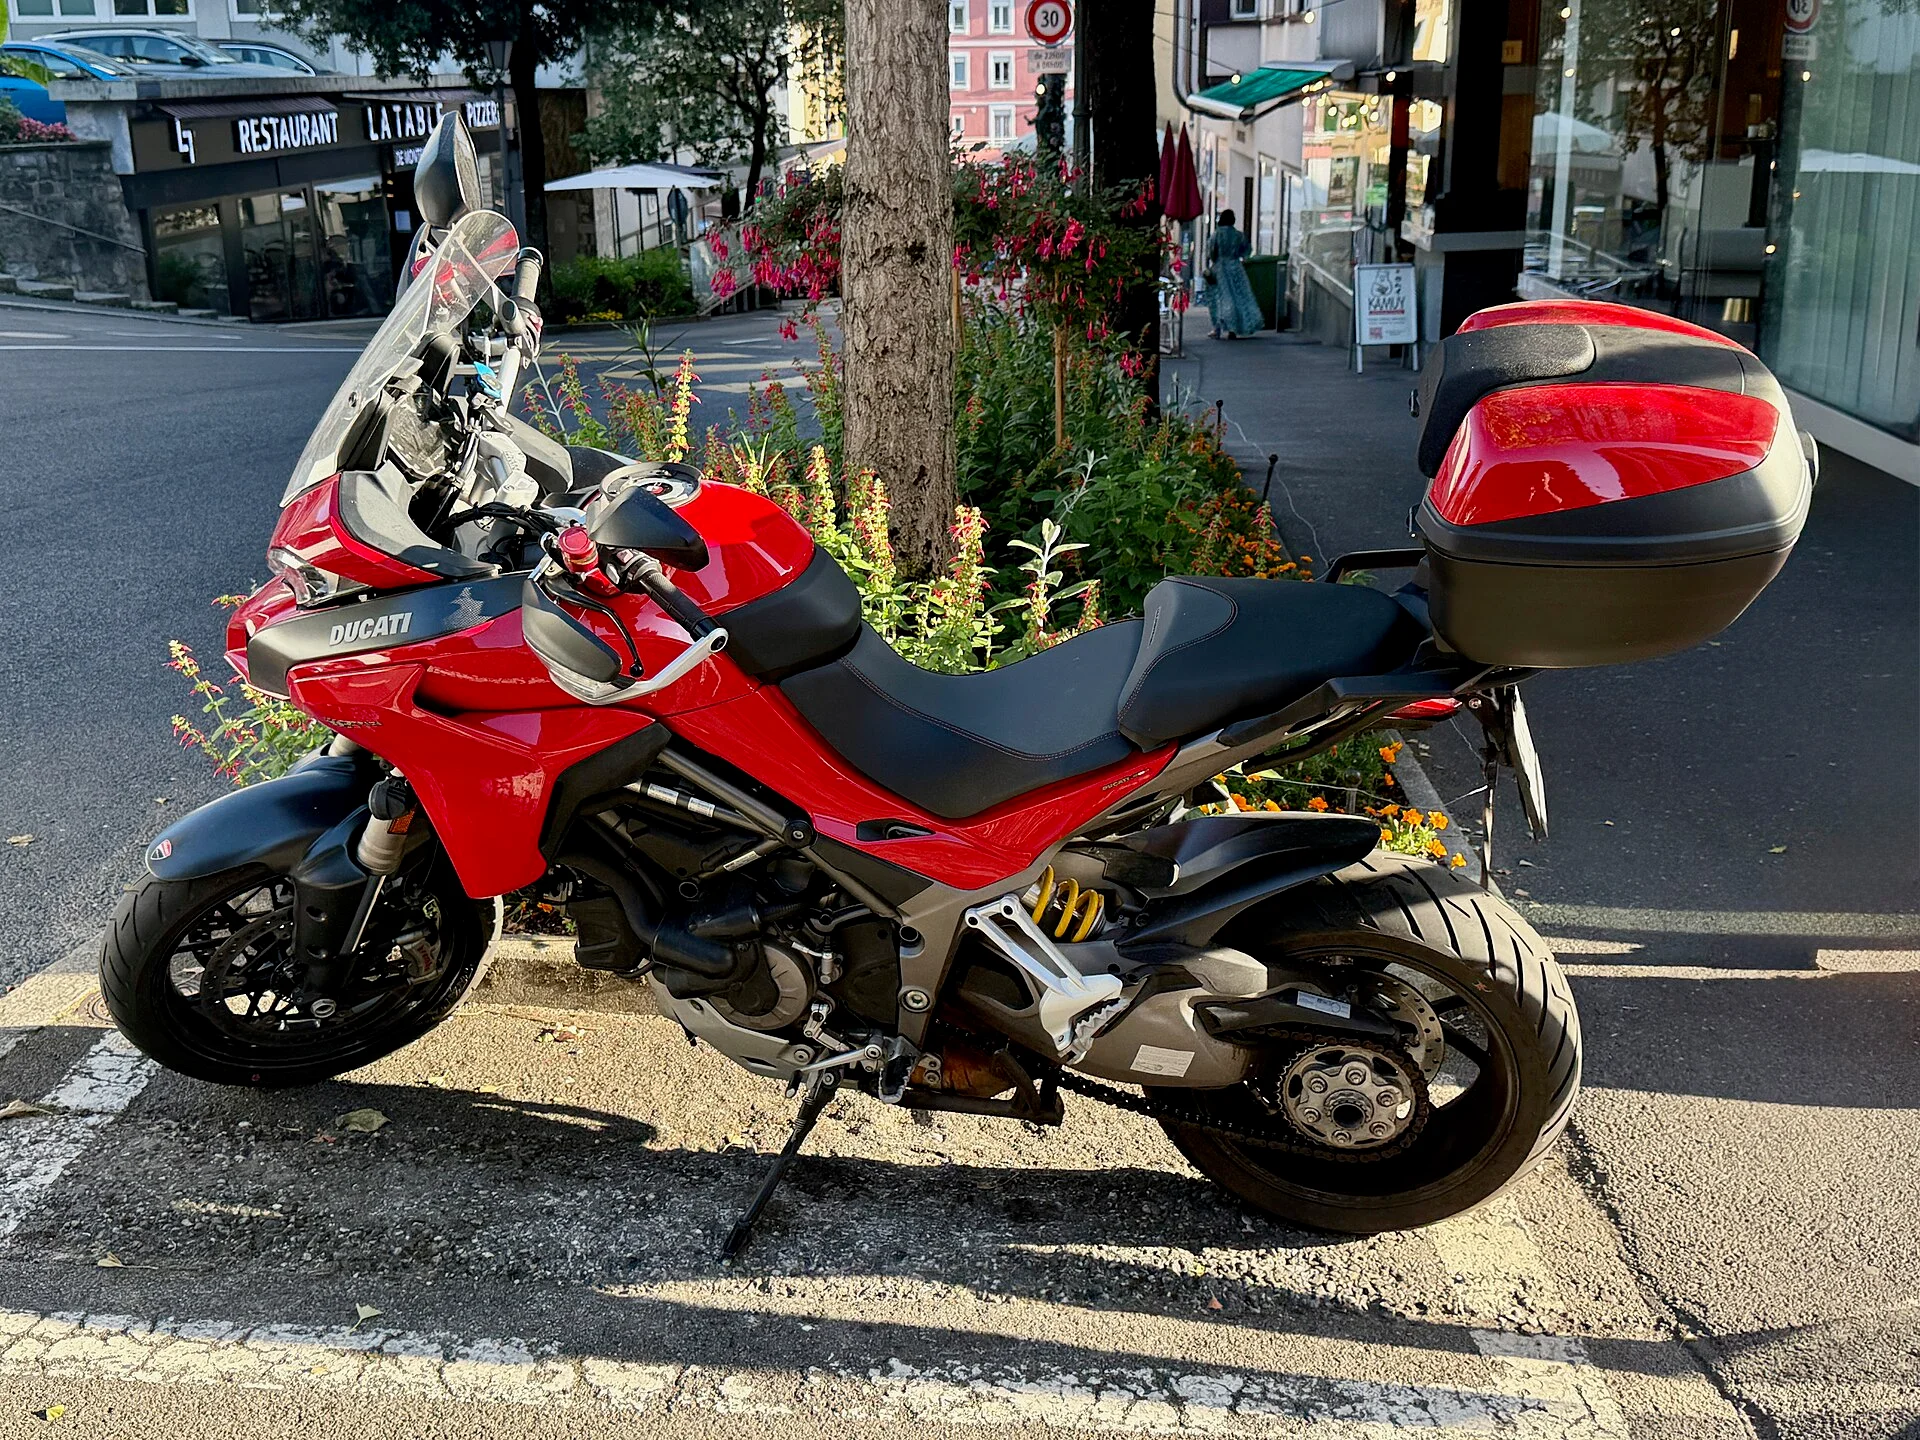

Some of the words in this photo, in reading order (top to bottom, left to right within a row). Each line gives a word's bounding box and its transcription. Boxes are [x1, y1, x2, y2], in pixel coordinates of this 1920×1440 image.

[1041, 10, 1059, 28] 30
[238, 112, 338, 153] RESTAURANT
[329, 612, 413, 646] DUCATI
